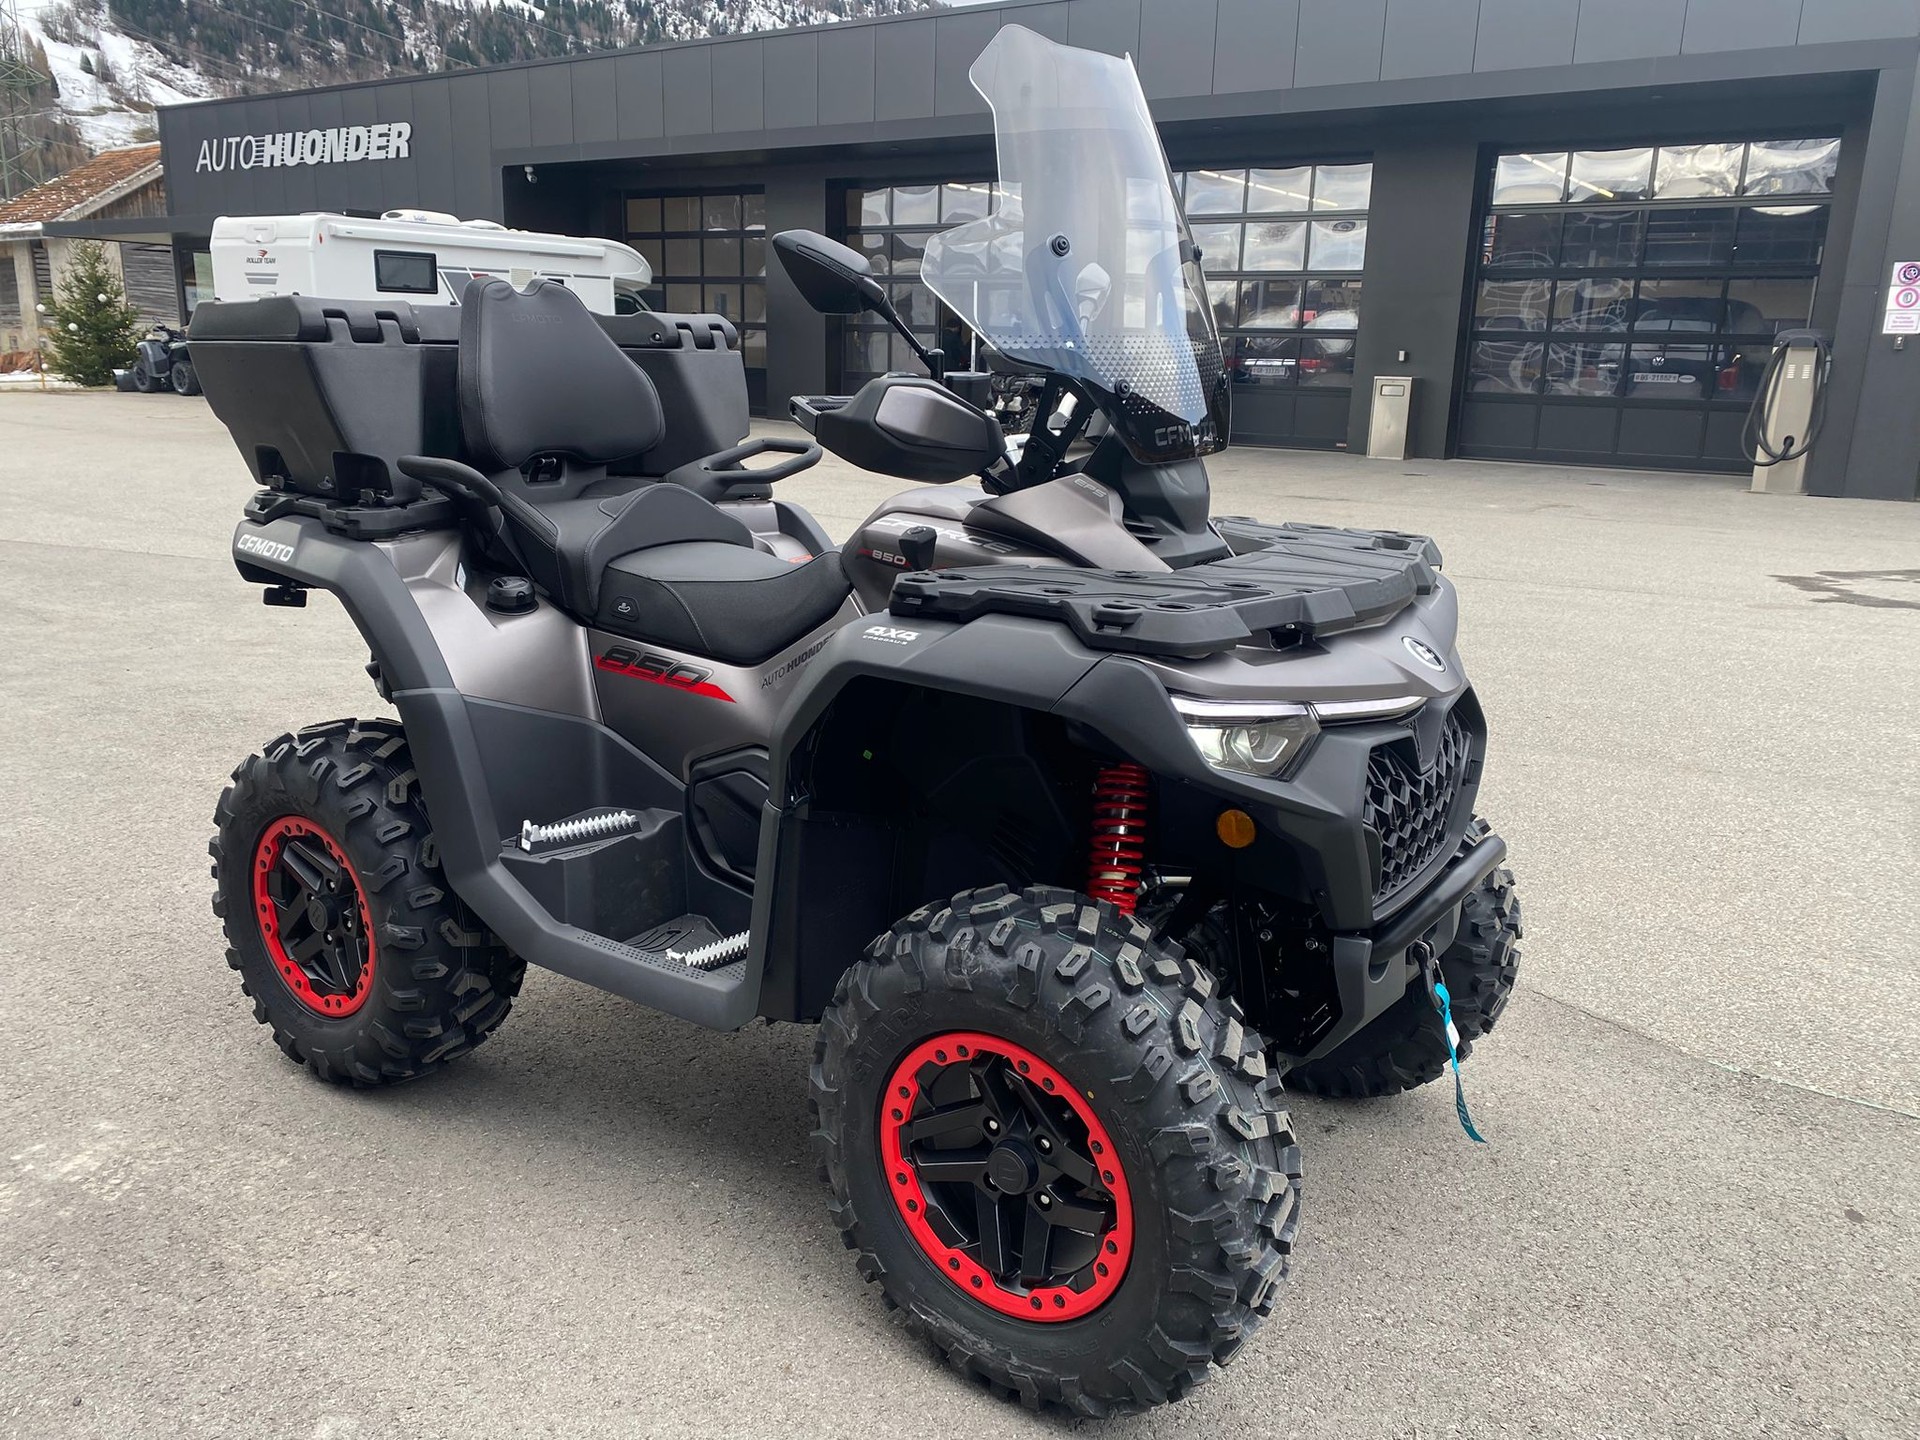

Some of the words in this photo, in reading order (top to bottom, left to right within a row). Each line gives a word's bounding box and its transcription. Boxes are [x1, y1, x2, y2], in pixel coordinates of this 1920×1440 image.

[196, 135, 256, 173] AUTO
[262, 122, 412, 168] HUONDER
[1074, 478, 1107, 498] EPS
[237, 533, 295, 562] CFMOTO
[872, 550, 906, 566] 850
[600, 644, 714, 688] 850
[761, 667, 785, 689] AUTO
